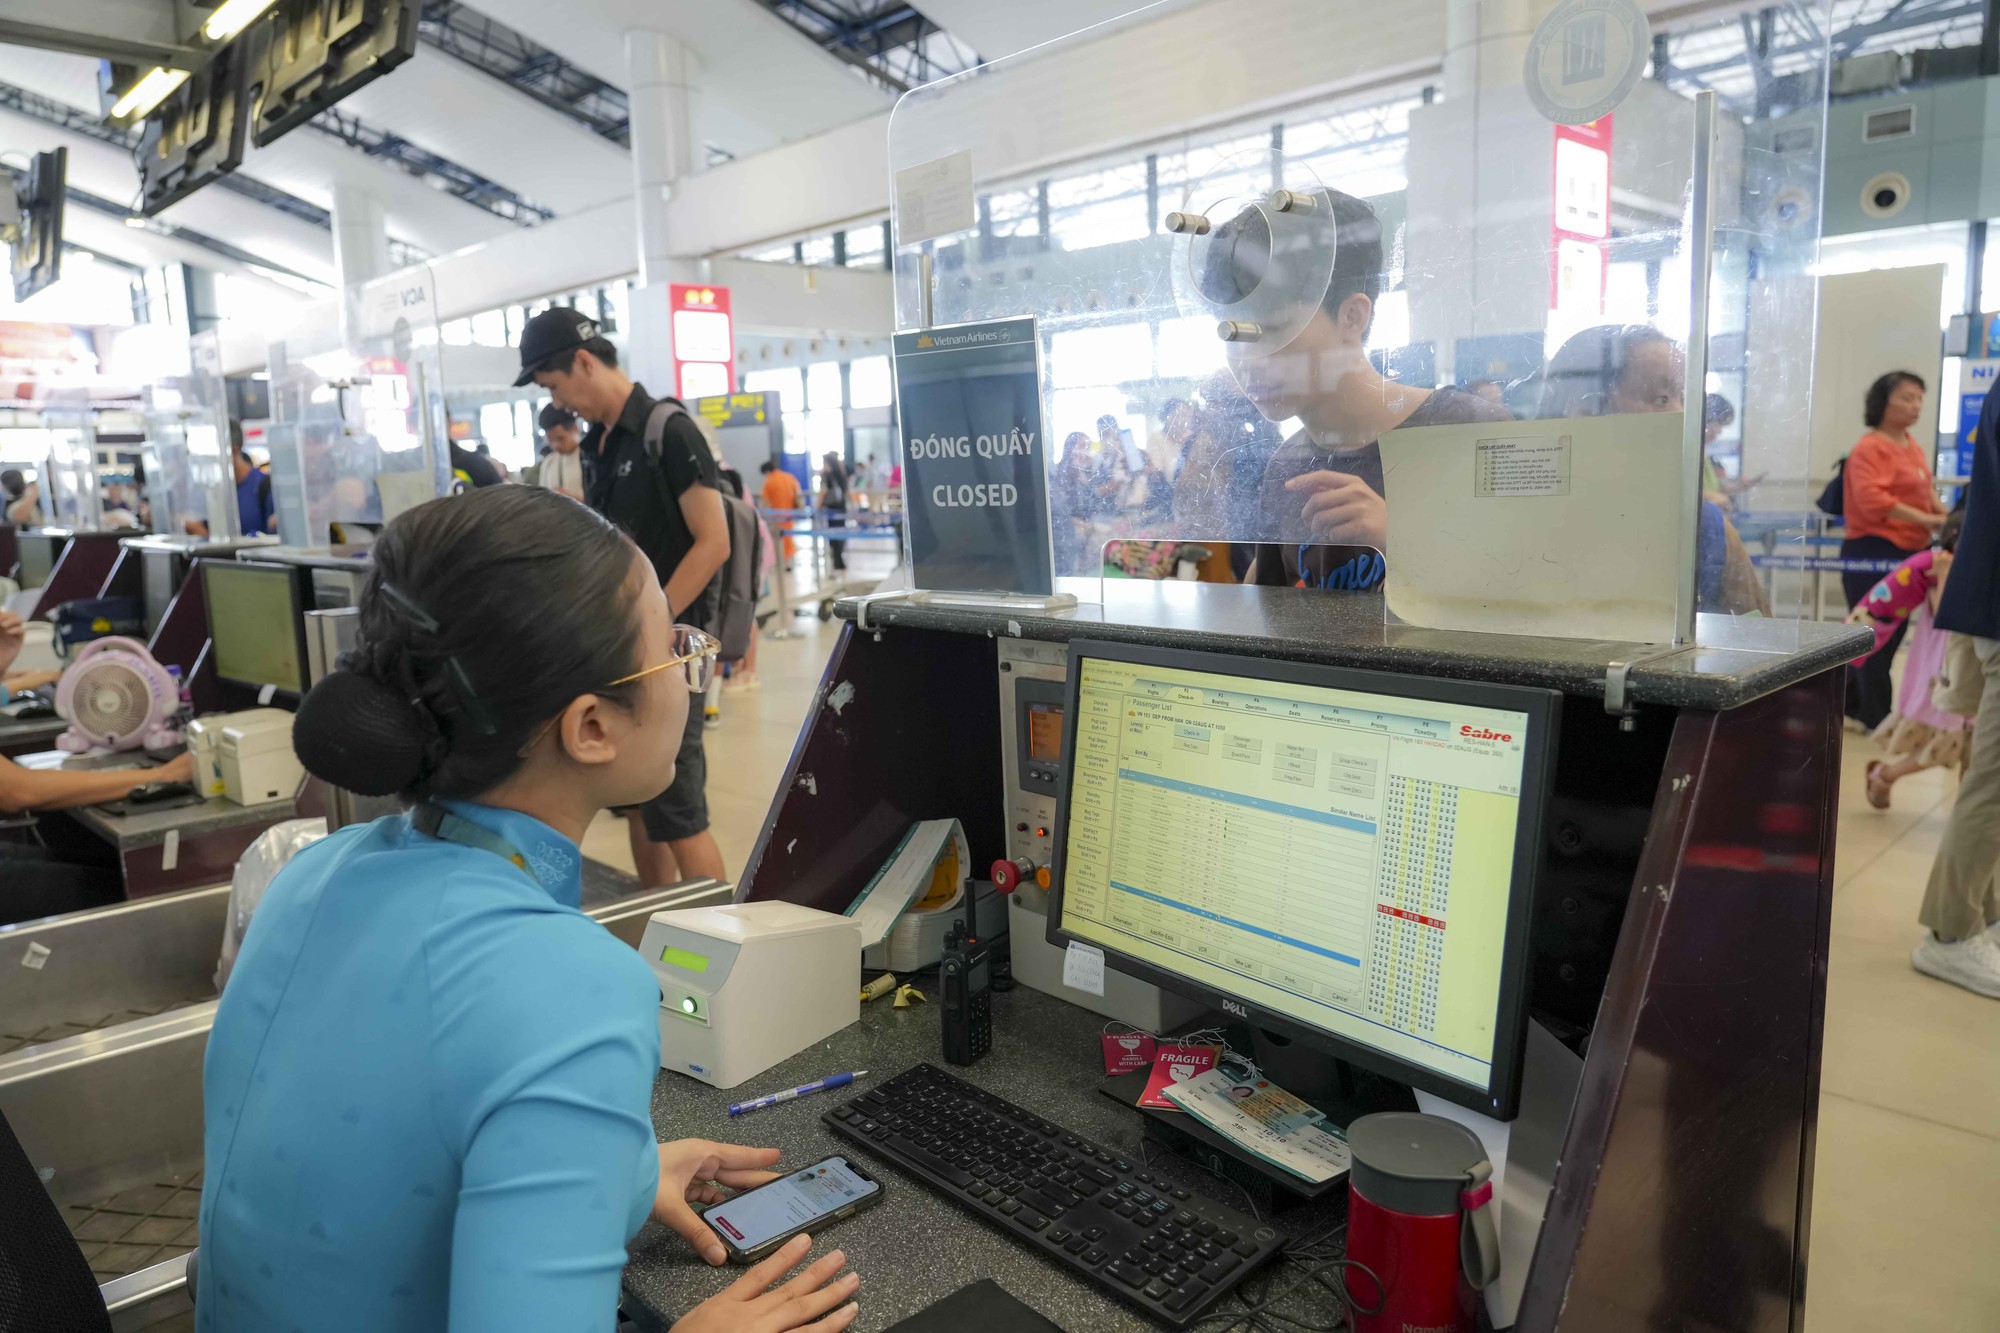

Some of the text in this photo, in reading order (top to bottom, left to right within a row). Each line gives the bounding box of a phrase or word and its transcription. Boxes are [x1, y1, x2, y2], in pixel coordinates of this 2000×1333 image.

[934, 331, 998, 346] Vietnam Airlines
[910, 427, 1036, 461] ĐÓNG QUẦY
[932, 483, 1018, 508] CLOSED
[1132, 698, 1160, 710] Passenger
[1212, 698, 1230, 707] Boarding
[1245, 704, 1268, 712] Operations
[1321, 714, 1350, 724] Reservations
[1414, 728, 1437, 738] Ticketing
[1460, 725, 1512, 742] Sabre
[1330, 806, 1376, 822] Similar Name List
[1244, 962, 1252, 970] List
[1332, 992, 1348, 1002] Cancel
[1223, 999, 1248, 1018] DELL
[1160, 1053, 1209, 1065] FRAGILE
[1263, 1128, 1286, 1144] 10:10
